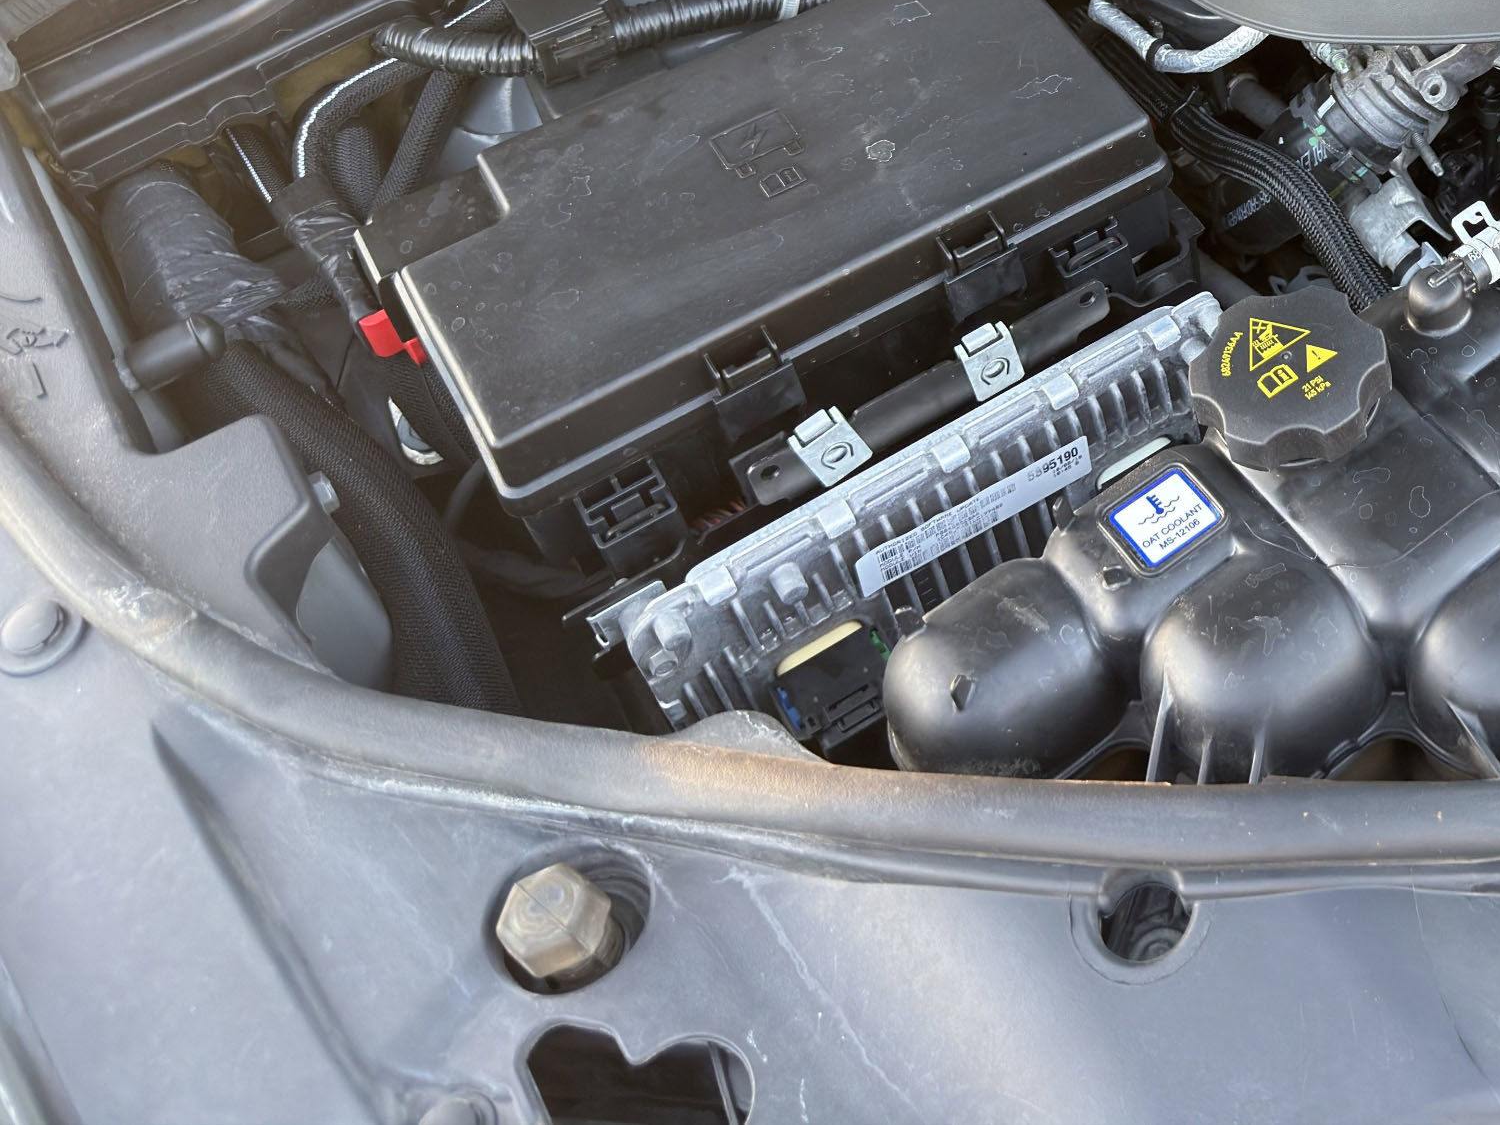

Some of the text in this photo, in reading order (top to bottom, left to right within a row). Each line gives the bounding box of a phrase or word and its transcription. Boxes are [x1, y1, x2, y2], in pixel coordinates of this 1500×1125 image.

[1302, 375, 1324, 393] 21 PSI
[1315, 381, 1332, 393] kPa
[1142, 502, 1202, 548] OAT COOLANT
